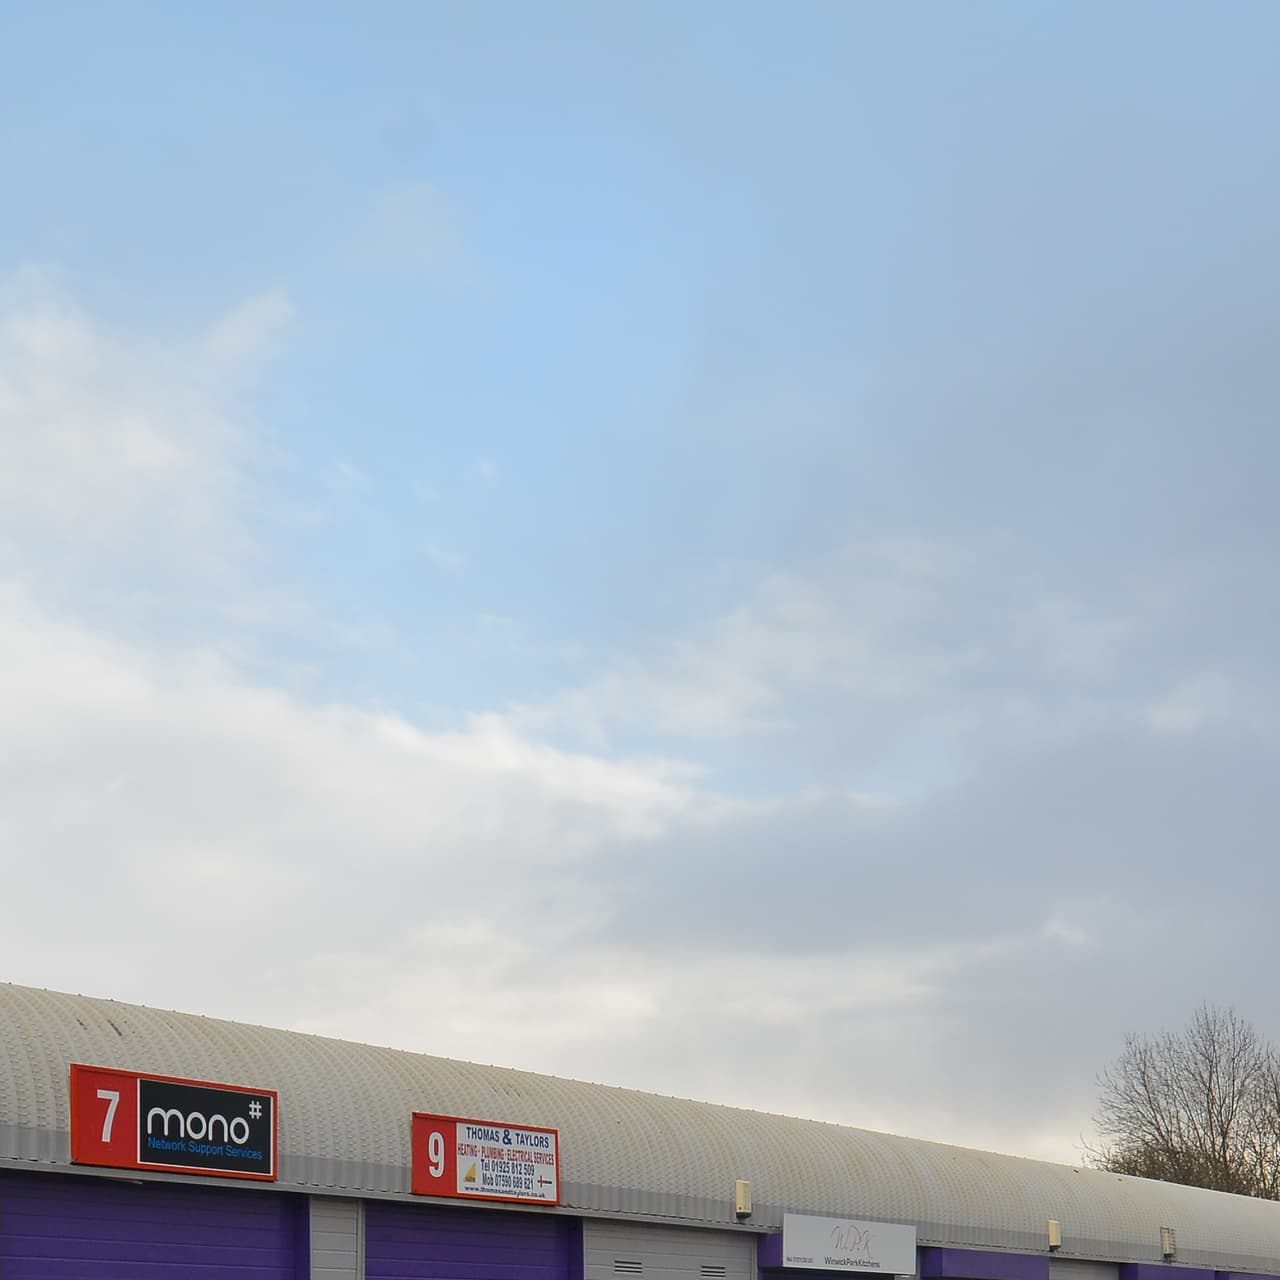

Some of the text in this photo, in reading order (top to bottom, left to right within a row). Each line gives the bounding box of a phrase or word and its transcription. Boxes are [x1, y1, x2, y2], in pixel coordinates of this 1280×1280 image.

[96, 1089, 120, 1143] 7
[148, 1137, 263, 1160] Network Support Services
[466, 1126, 550, 1149] THOMAS & TAYLORS
[428, 1132, 445, 1178] 9
[458, 1143, 554, 1166] HEATING PLUMBING ELECTRICAL SERVICES
[480, 1159, 490, 1172] Tel
[491, 1160, 510, 1174] 01925
[482, 1173, 494, 1187] Mob
